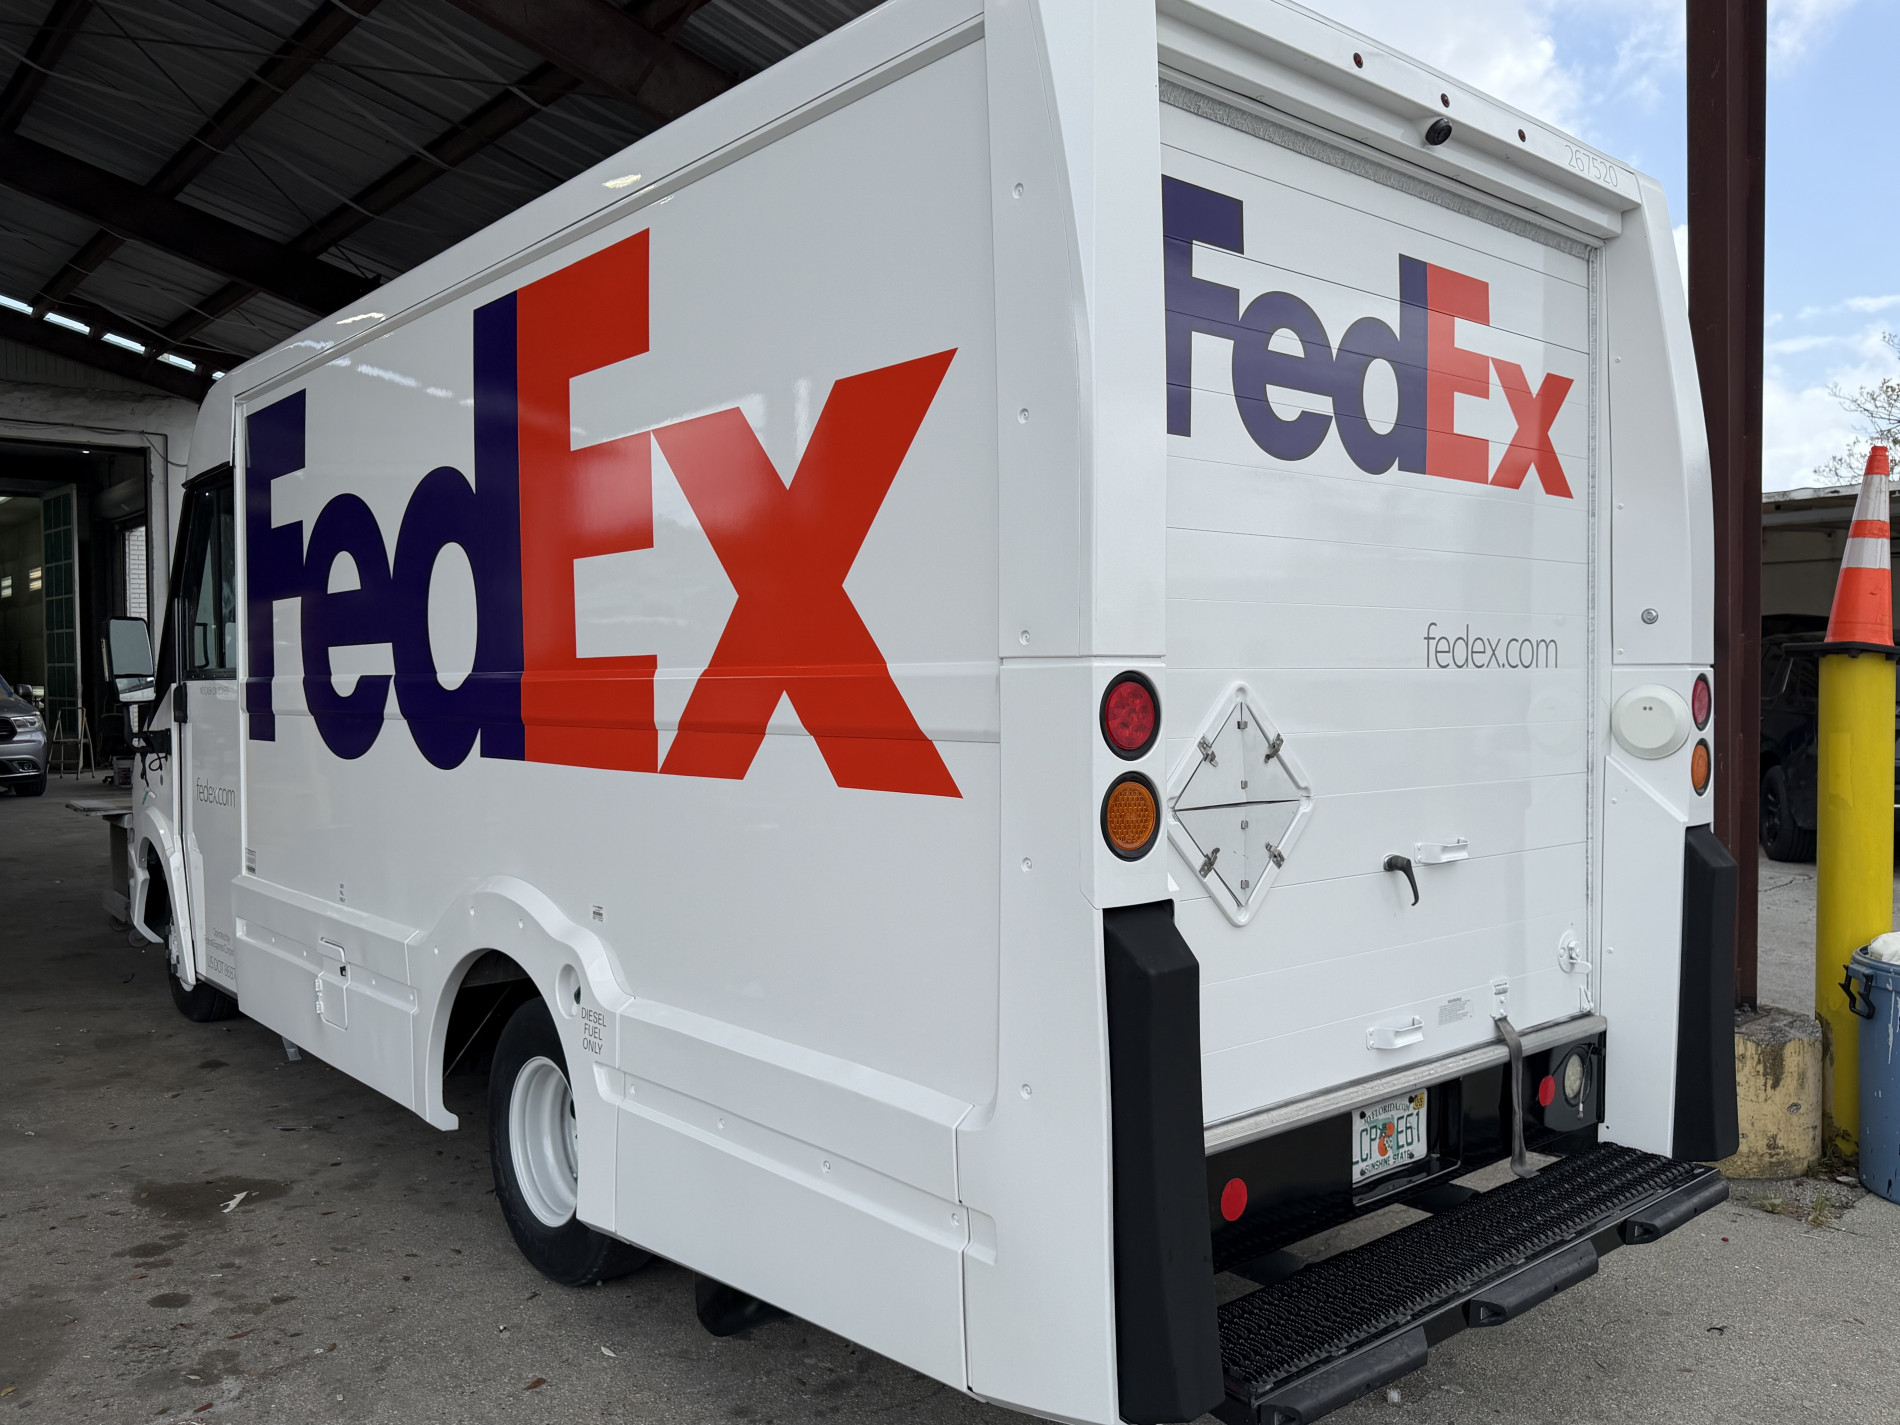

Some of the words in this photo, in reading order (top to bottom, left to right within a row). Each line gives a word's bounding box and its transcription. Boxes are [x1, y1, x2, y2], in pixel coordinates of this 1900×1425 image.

[1564, 144, 1618, 188] 267520
[1161, 173, 1575, 500] FedEx
[246, 227, 964, 799] FedEx
[1423, 621, 1558, 669] fedex.com
[196, 777, 236, 808] fedex.com
[581, 1006, 607, 1028] DIESEL
[584, 1022, 603, 1041] FUEL
[582, 1037, 603, 1055] ONLY
[1364, 1156, 1391, 1174] SUNSHINE
[1392, 1149, 1411, 1164] STATE
